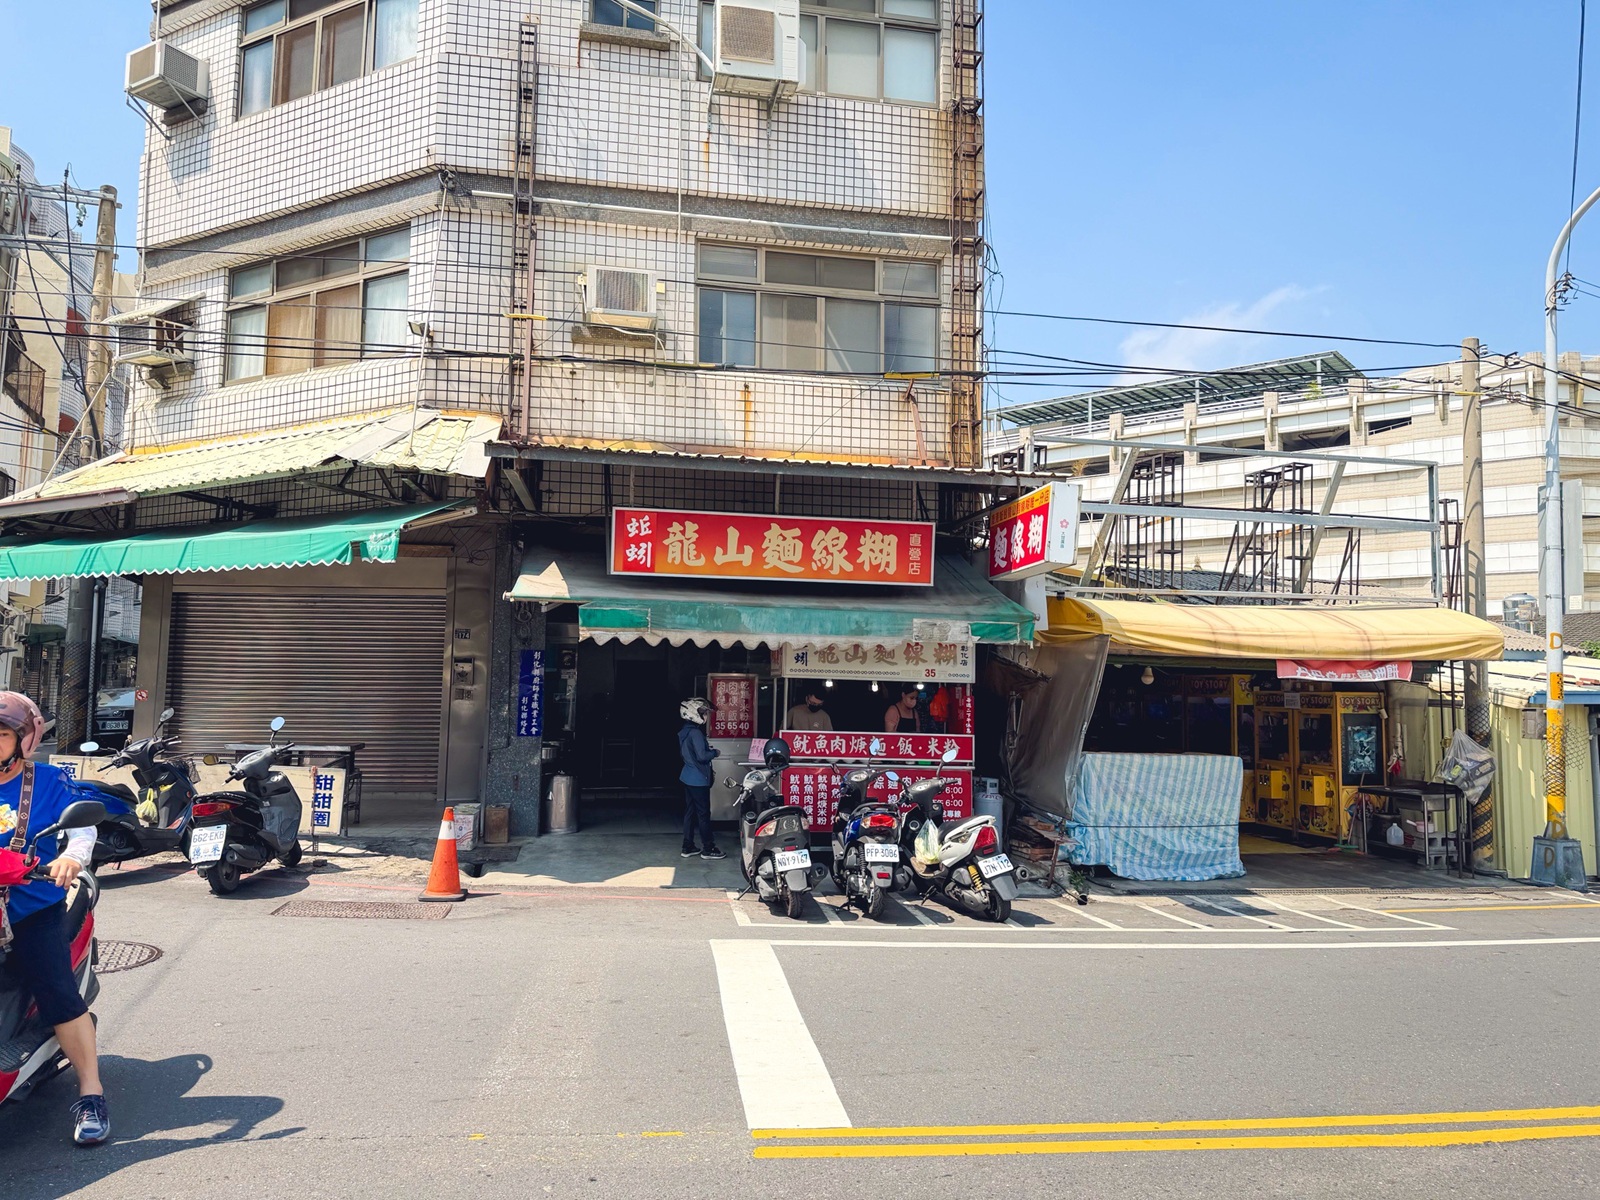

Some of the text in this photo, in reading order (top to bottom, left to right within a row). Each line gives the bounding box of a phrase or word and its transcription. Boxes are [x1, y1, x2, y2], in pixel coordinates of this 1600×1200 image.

[625, 514, 652, 568] 蚯蚓
[993, 514, 1045, 568] 麵線糊
[662, 520, 898, 575] 龍山麵線糊
[908, 533, 922, 575] 直營店
[794, 645, 809, 667] 蚓
[960, 645, 969, 667] 彰化店
[924, 668, 936, 678] 35
[1311, 695, 1332, 705] STORY
[1340, 697, 1381, 706] TOY STORY
[715, 722, 726, 730] 35
[727, 722, 738, 730] 65
[739, 722, 750, 730] 40
[945, 786, 963, 794] 6:00
[313, 774, 335, 827] 甜甜圈
[945, 799, 963, 807] 6:00
[866, 848, 898, 858] PFP-3086
[777, 853, 808, 868] NQY-9167
